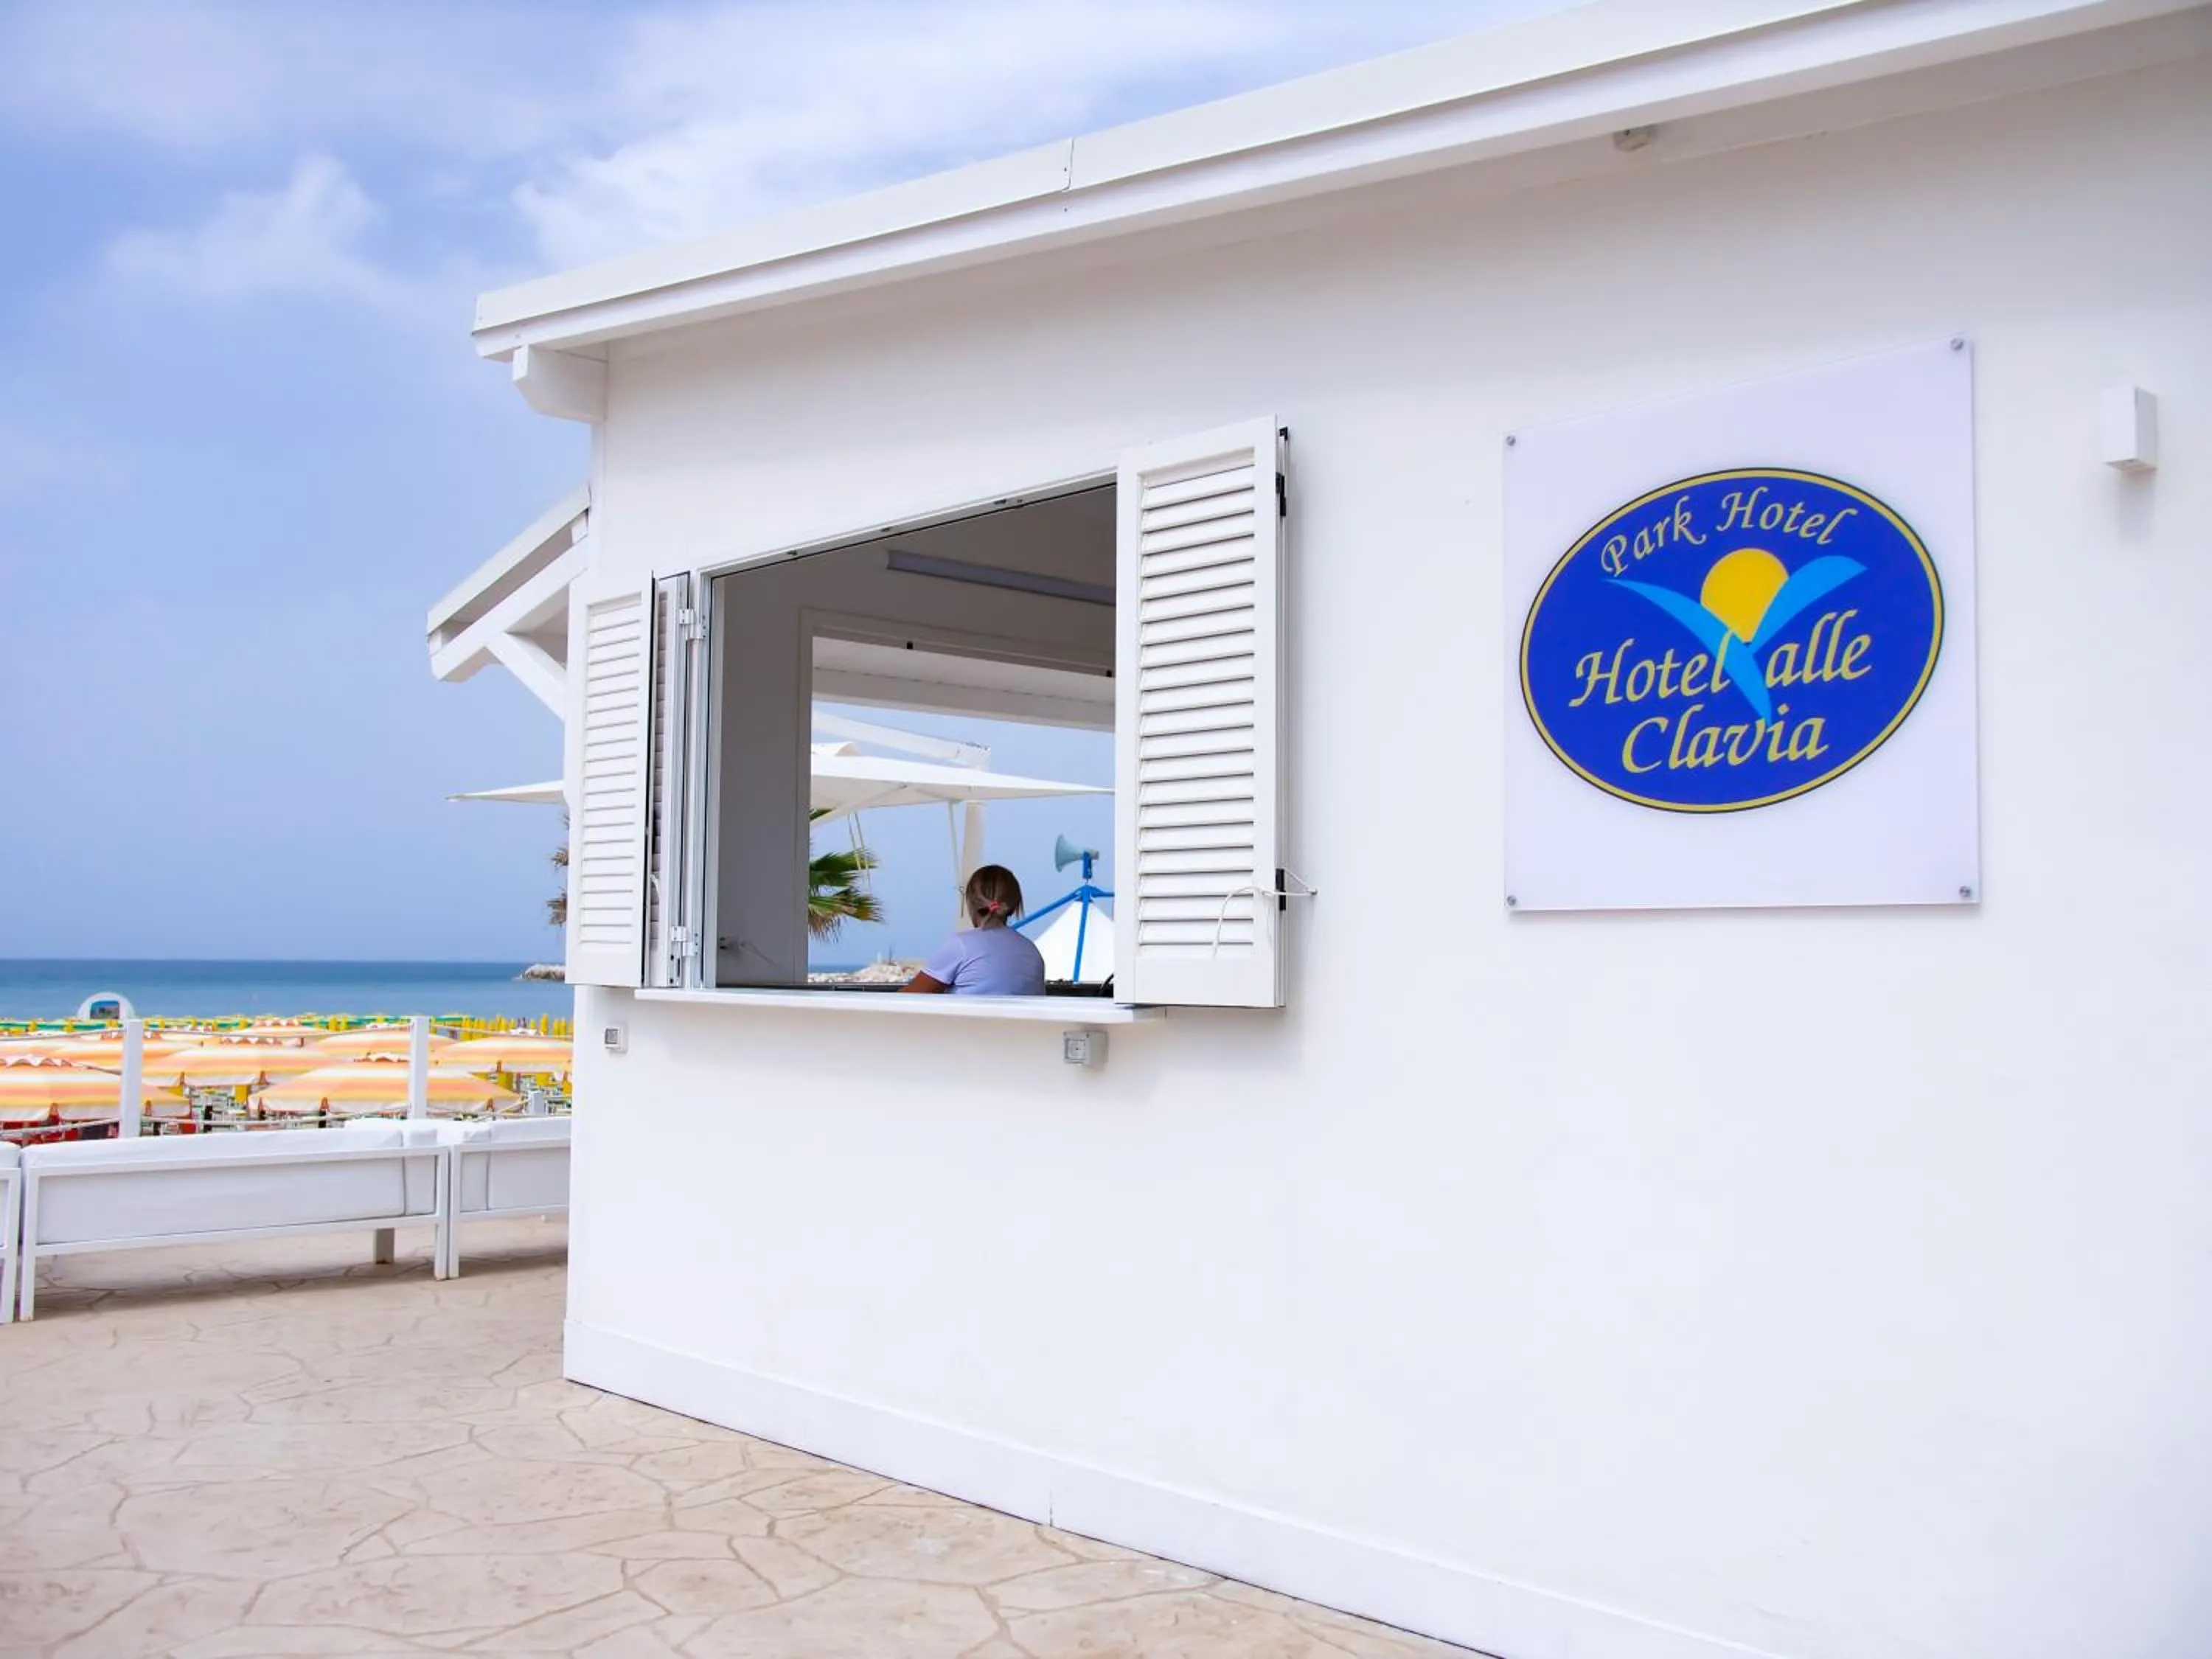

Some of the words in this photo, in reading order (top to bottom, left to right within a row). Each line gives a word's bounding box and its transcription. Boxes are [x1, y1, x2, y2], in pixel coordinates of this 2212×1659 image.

[1600, 495, 1706, 577] Park
[1716, 487, 1857, 544] Hotel
[1568, 630, 1731, 707] Hotel
[1621, 704, 1829, 773] Clavia
